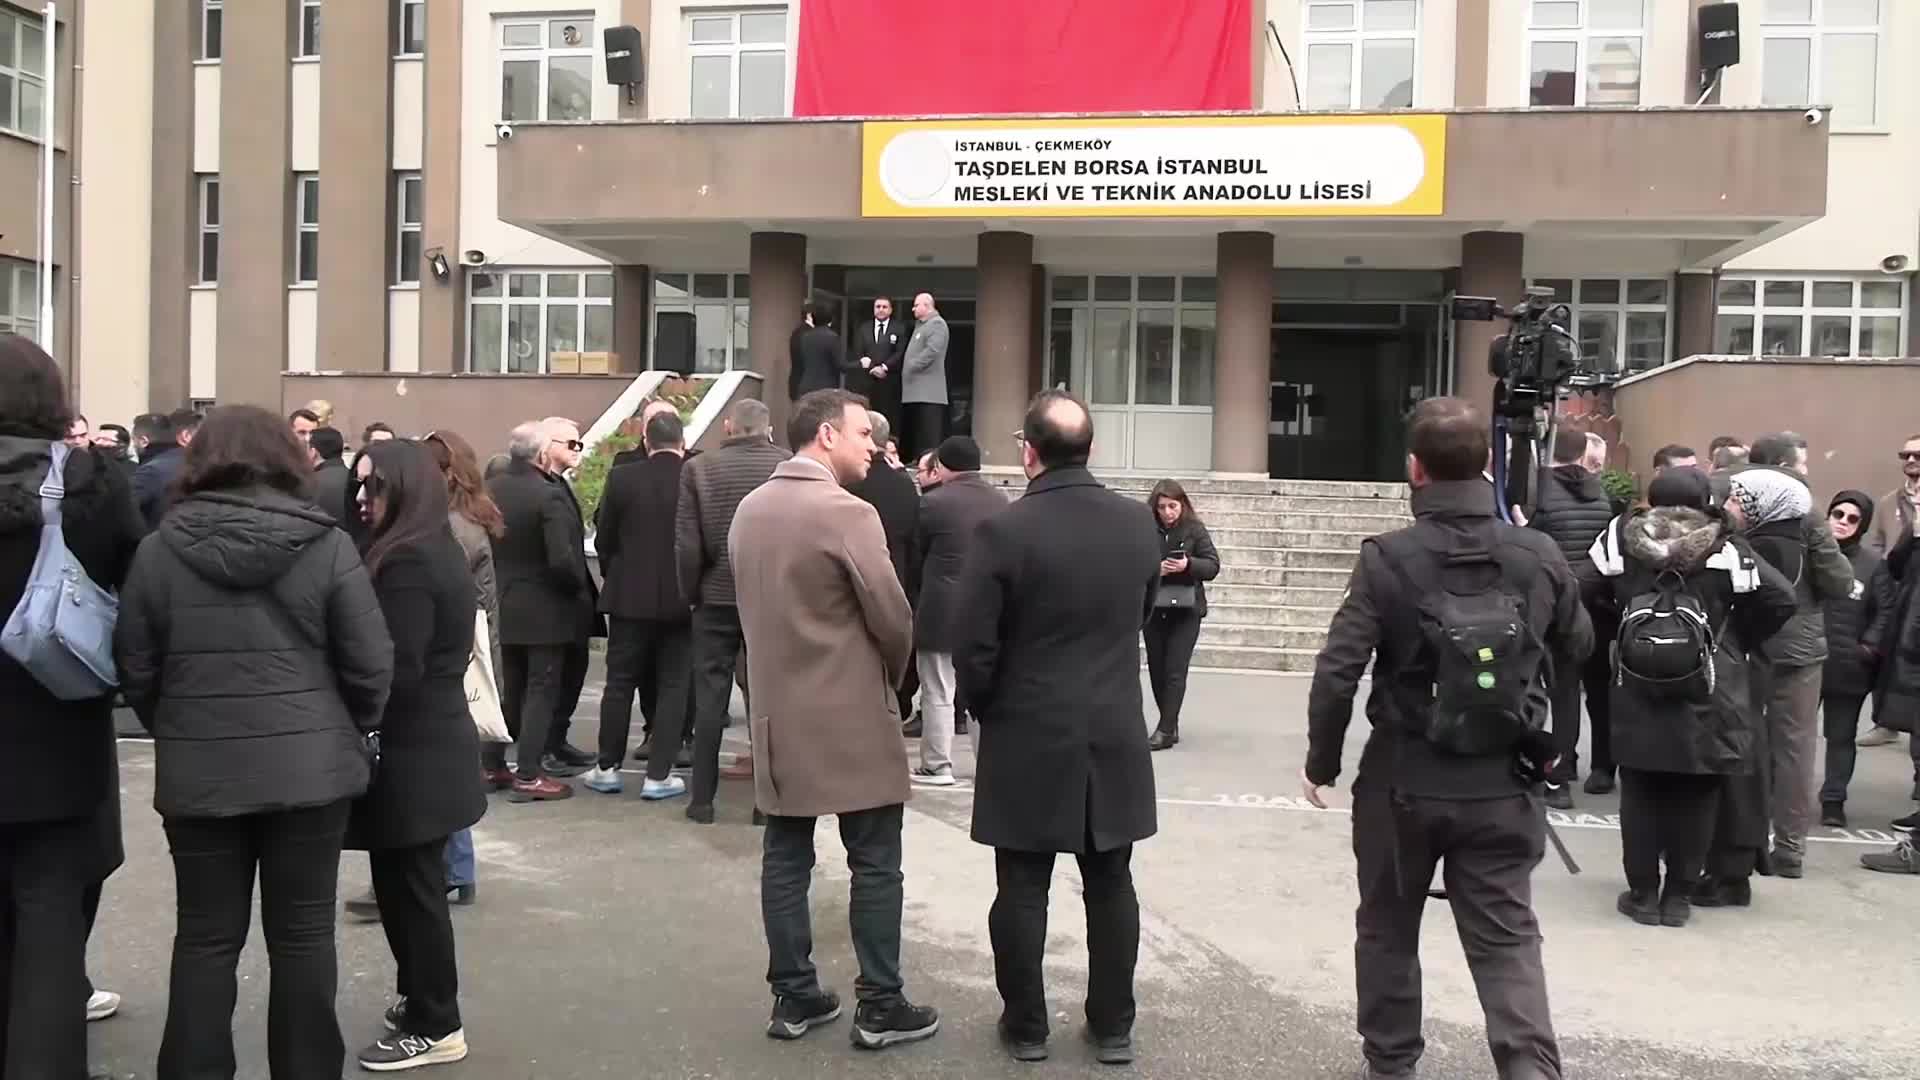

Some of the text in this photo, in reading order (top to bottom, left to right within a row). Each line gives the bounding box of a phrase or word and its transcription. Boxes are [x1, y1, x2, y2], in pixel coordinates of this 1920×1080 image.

[955, 140, 1022, 152] İSTANBUL
[1035, 139, 1112, 153] ÇEKMEKÖY
[954, 156, 1268, 180] TAŞDELEN BORSA İSTANBUL
[954, 180, 1371, 201] MESLEKİ VE TEKNİK ANADOLU LİSESİ
